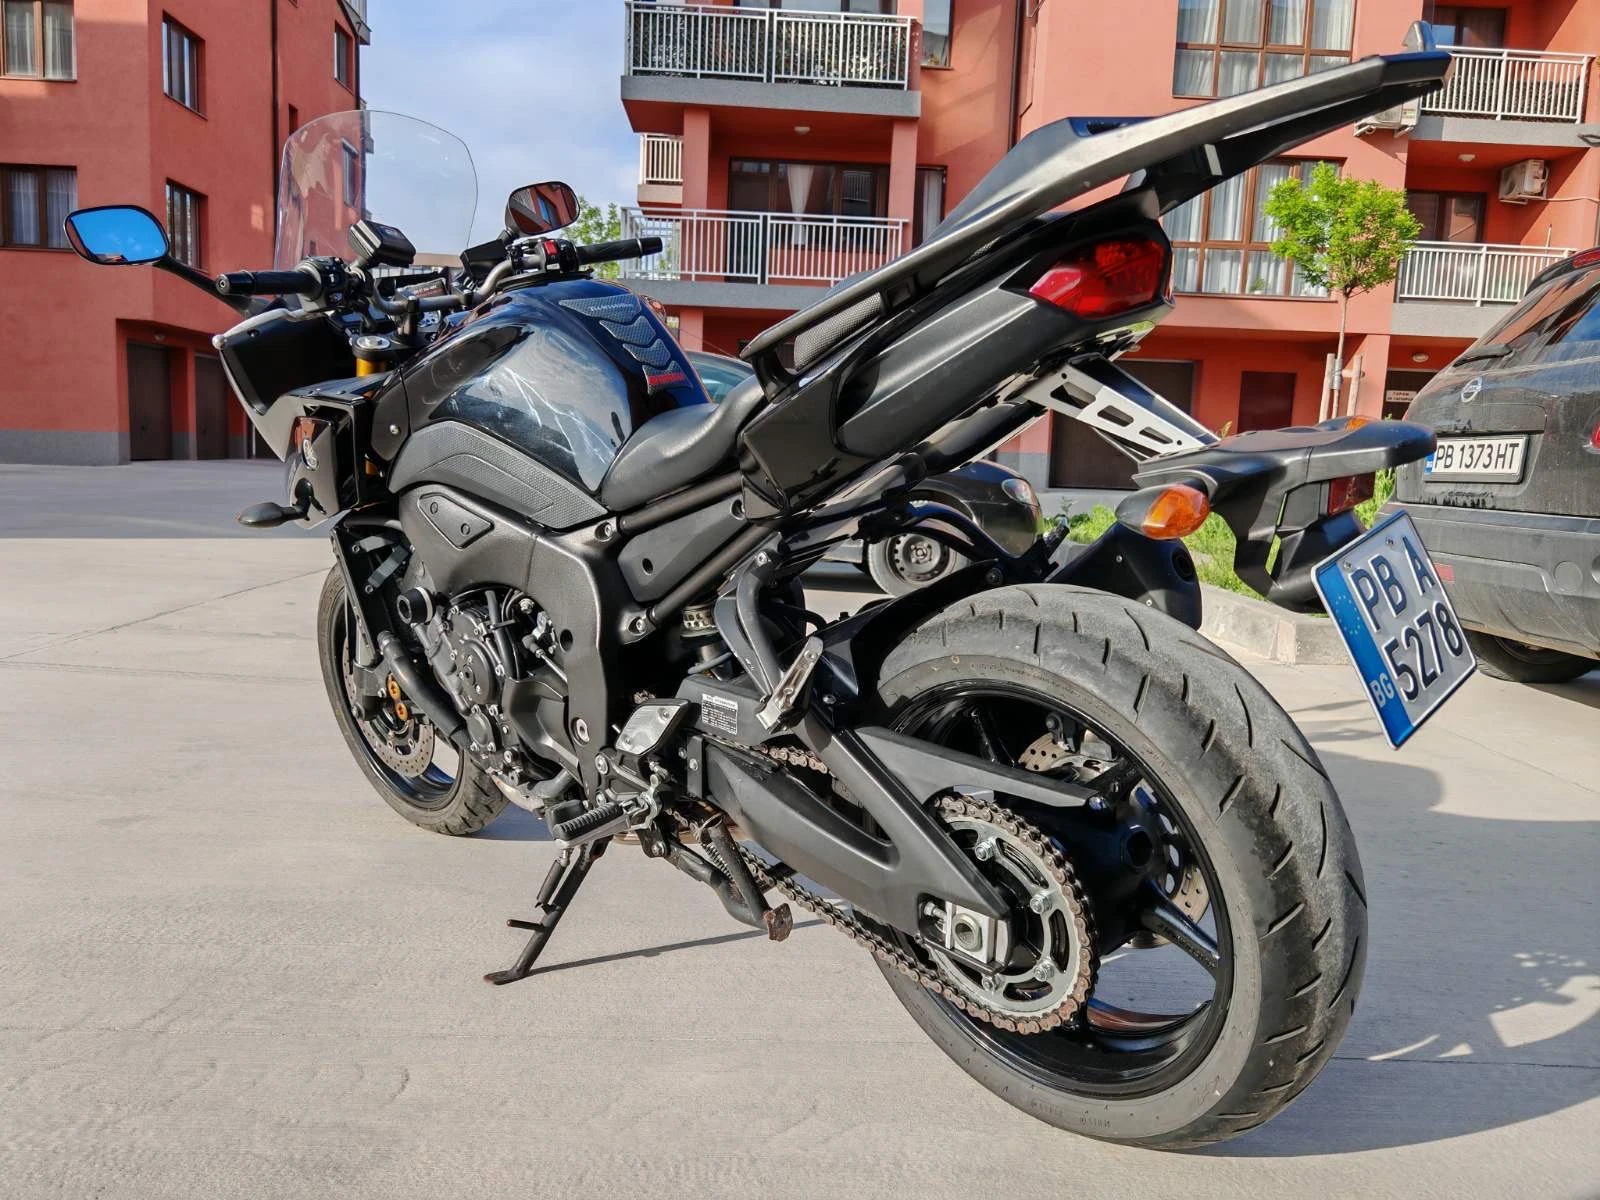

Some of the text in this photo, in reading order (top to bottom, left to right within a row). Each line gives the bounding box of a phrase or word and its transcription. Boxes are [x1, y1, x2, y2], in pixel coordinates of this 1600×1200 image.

[1435, 443, 1519, 469] PB 1373 HT
[1348, 536, 1435, 633] PB A
[1382, 600, 1463, 702] 5278
[1369, 673, 1395, 708] BG
